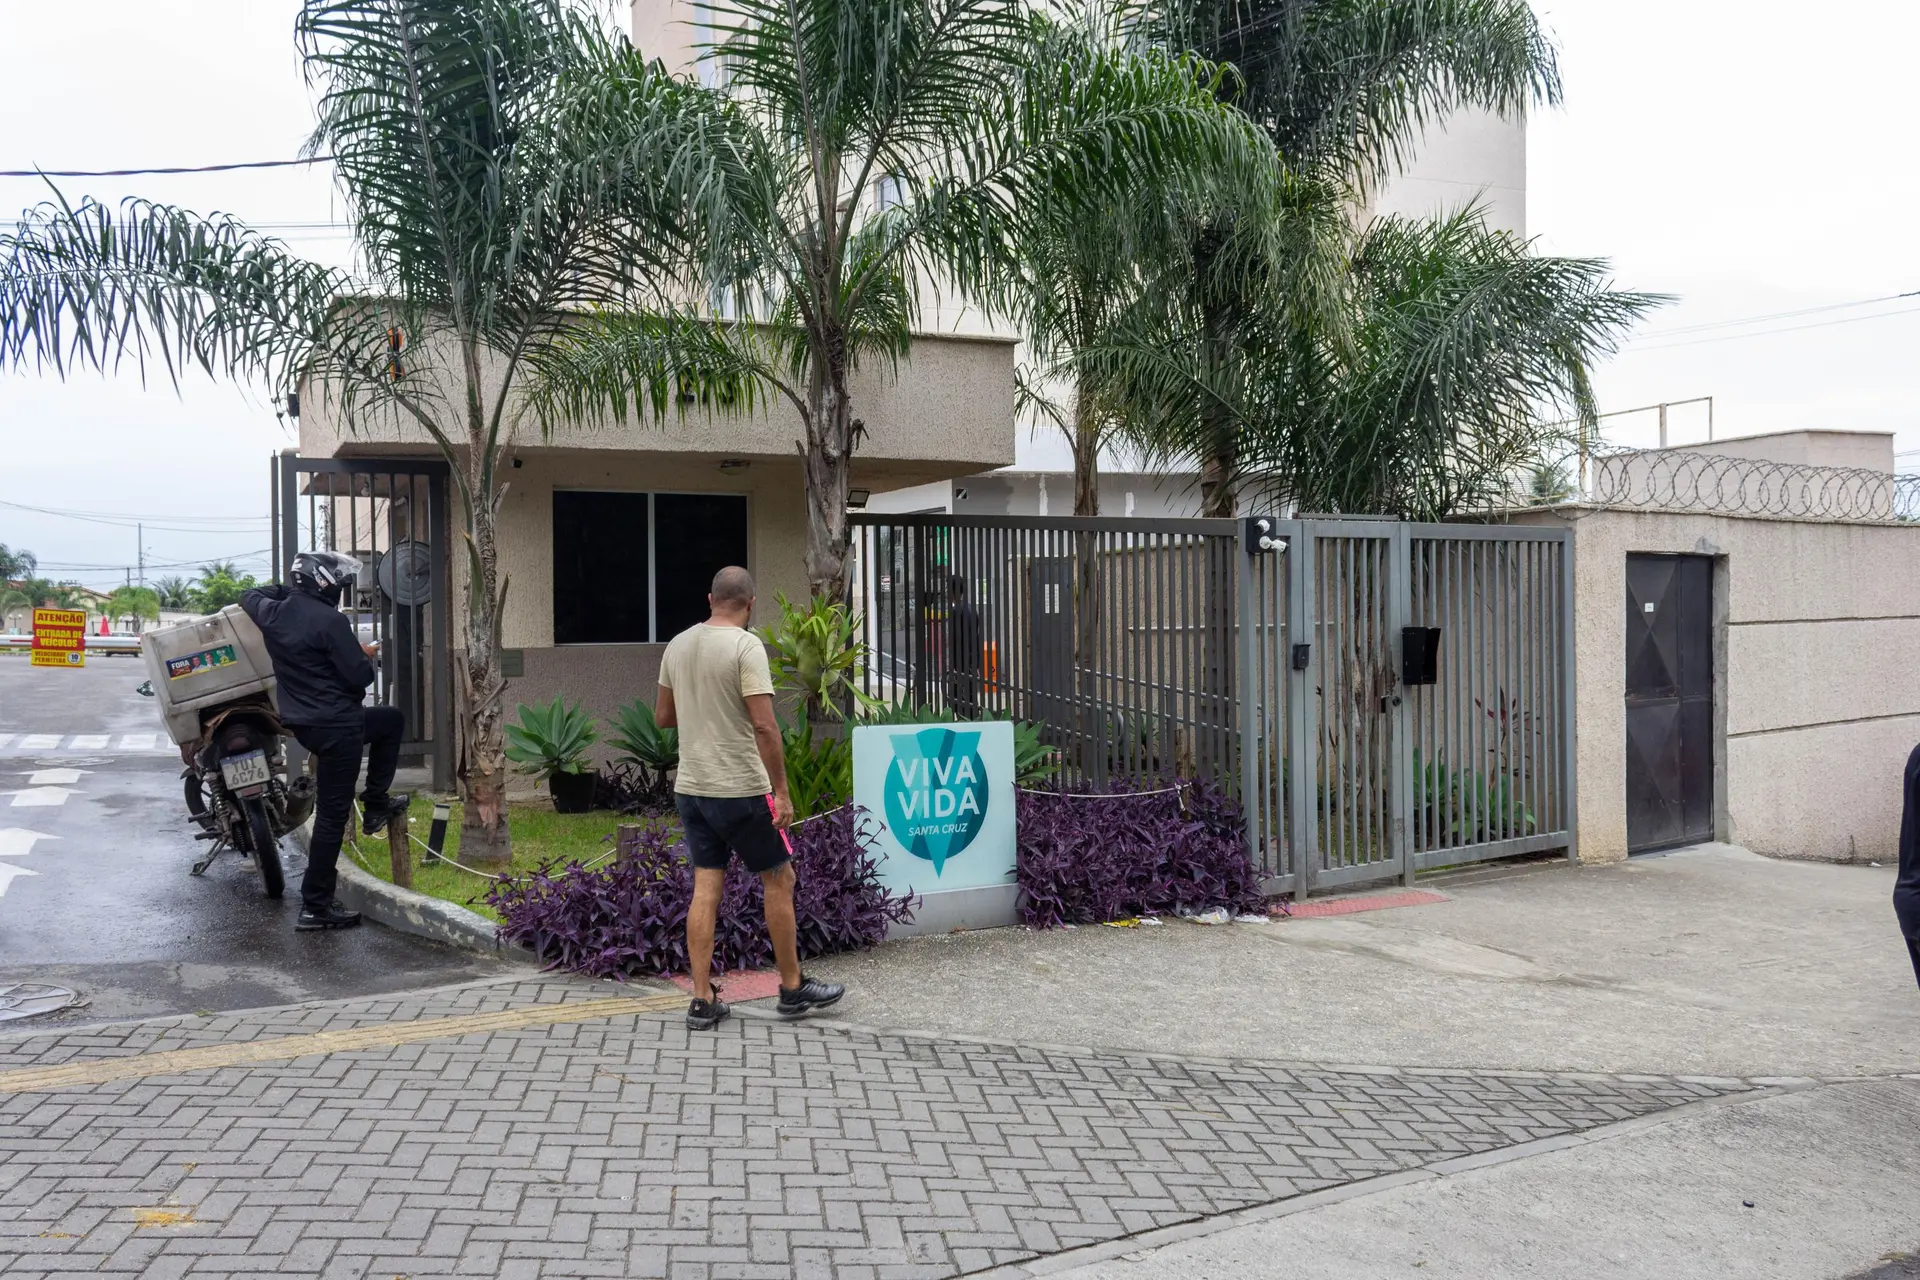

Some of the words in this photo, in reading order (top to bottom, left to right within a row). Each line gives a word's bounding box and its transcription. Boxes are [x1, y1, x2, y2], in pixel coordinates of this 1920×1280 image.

[37, 612, 83, 624] ATENÇÃO
[36, 629, 71, 638] ENTRADA
[72, 631, 82, 639] DE
[40, 637, 78, 647] VEÍCULOS
[171, 660, 190, 670] FORA
[232, 767, 265, 785] 6C76
[896, 755, 978, 788] VIVA
[897, 786, 981, 820] VIDA
[908, 825, 940, 837] SANTA
[942, 823, 969, 834] CRUZ
